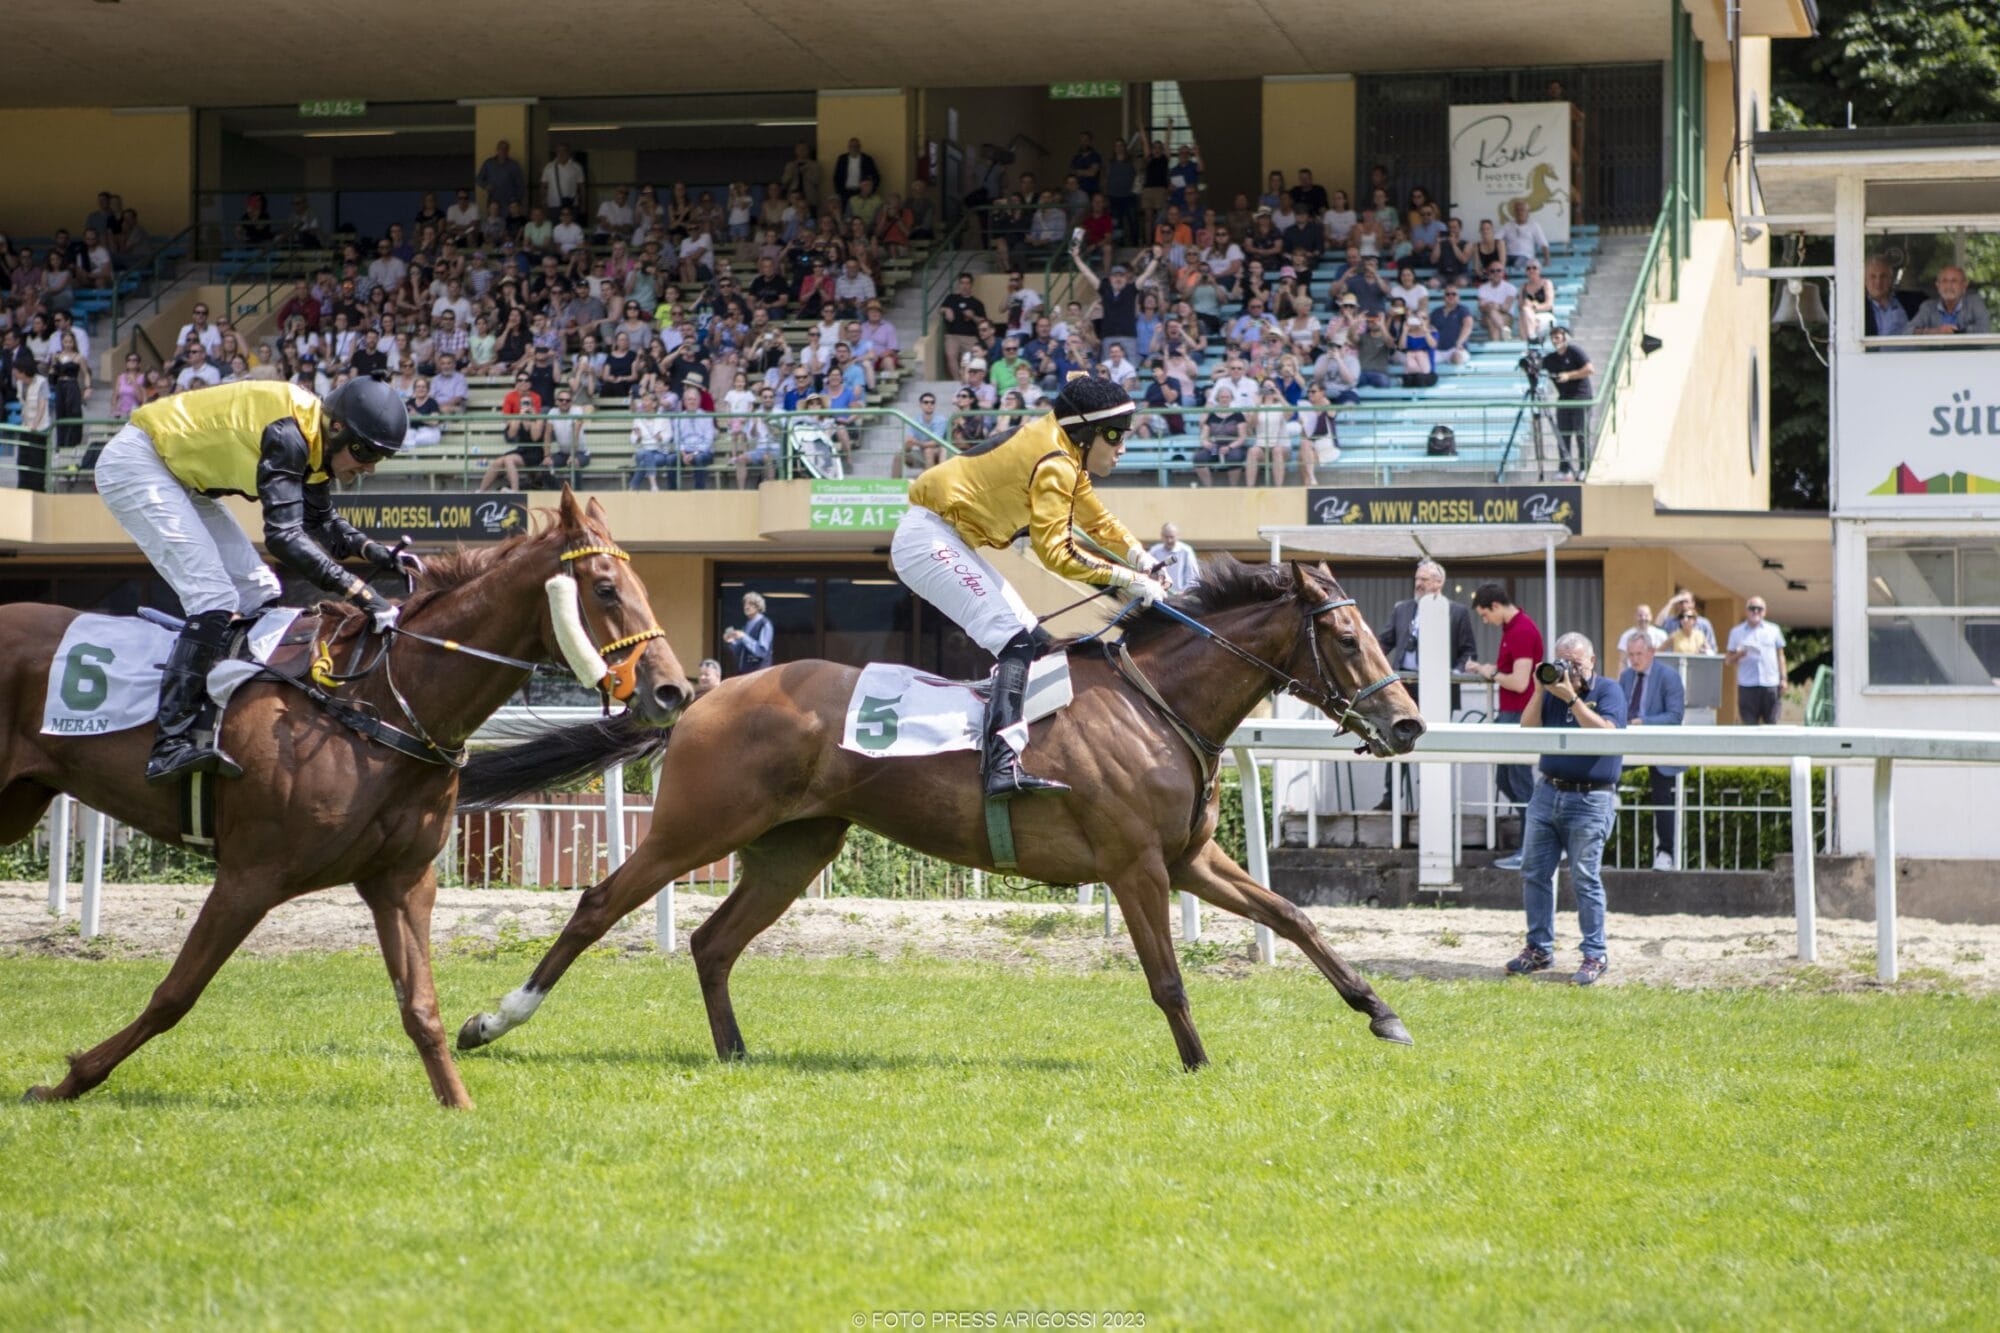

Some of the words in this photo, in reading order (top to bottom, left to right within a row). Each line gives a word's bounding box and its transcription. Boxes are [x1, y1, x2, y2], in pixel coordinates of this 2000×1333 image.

[1067, 83, 1086, 98] A2
[1089, 83, 1106, 98] A1
[829, 507, 854, 526] A2
[861, 507, 885, 526] A1
[1369, 499, 1519, 523] WWW.ROESSL.COM
[60, 642, 116, 712] 6
[50, 718, 110, 732] MERAN
[855, 694, 903, 750] 5
